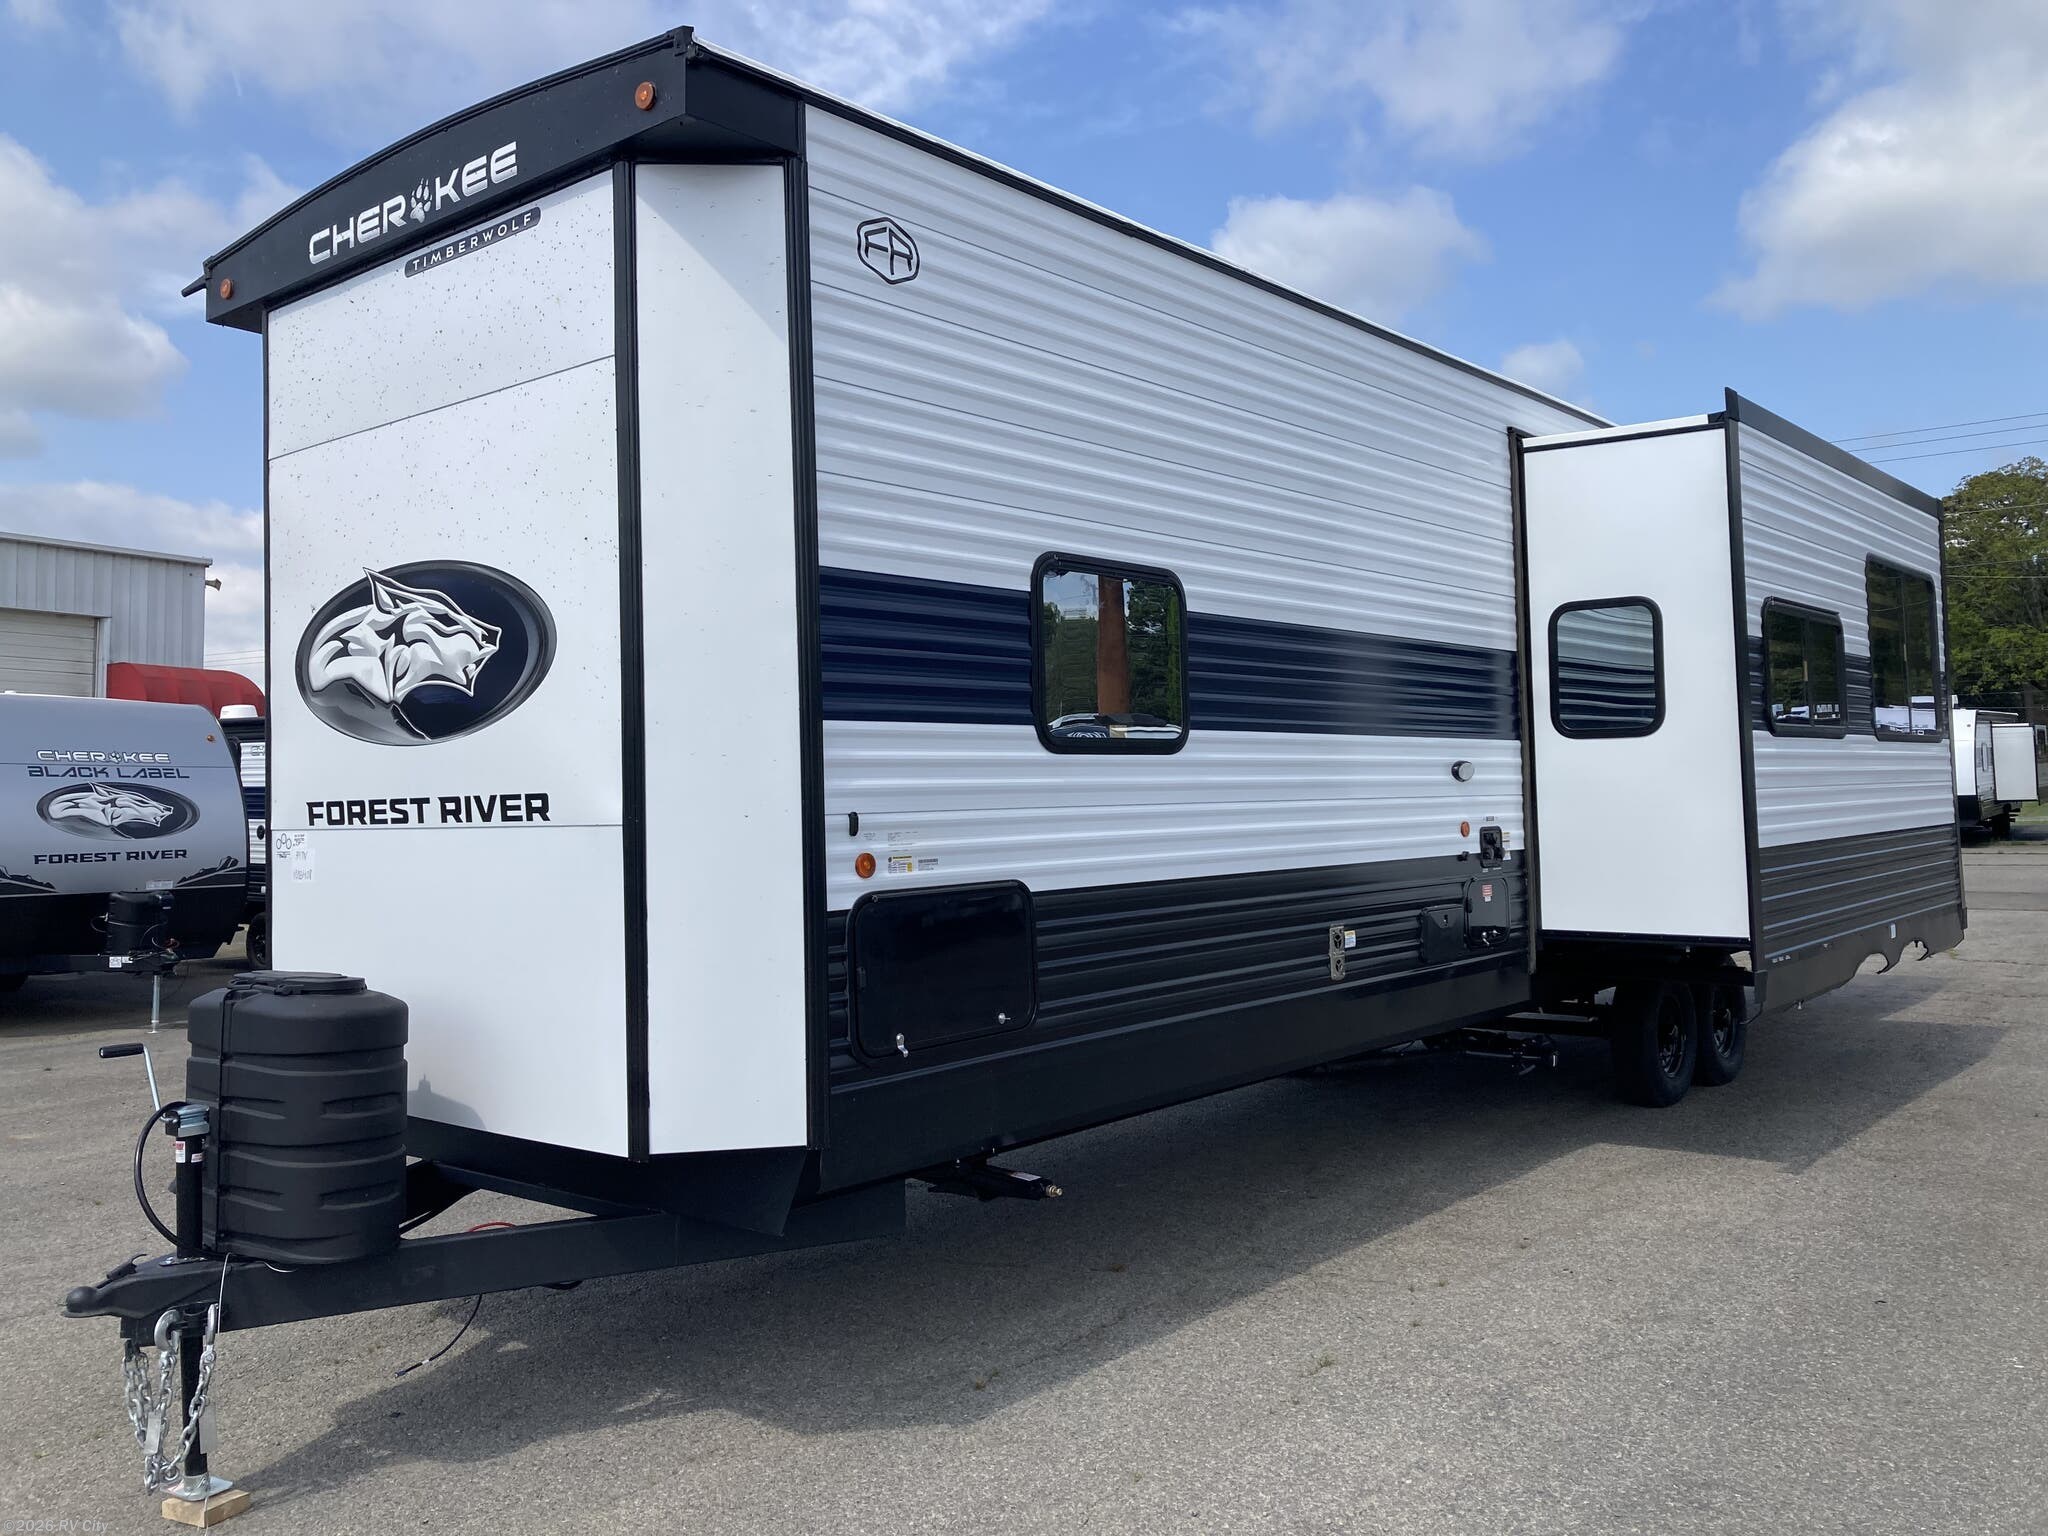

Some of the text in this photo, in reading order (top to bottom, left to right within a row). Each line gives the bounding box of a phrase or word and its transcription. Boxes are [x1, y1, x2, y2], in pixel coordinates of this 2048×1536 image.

[412, 212, 533, 271] TIMBERWOLF
[27, 765, 190, 779] BLACK LABEL
[306, 792, 551, 826] FOREST RIVER
[33, 849, 188, 865] FOREST RIVER
